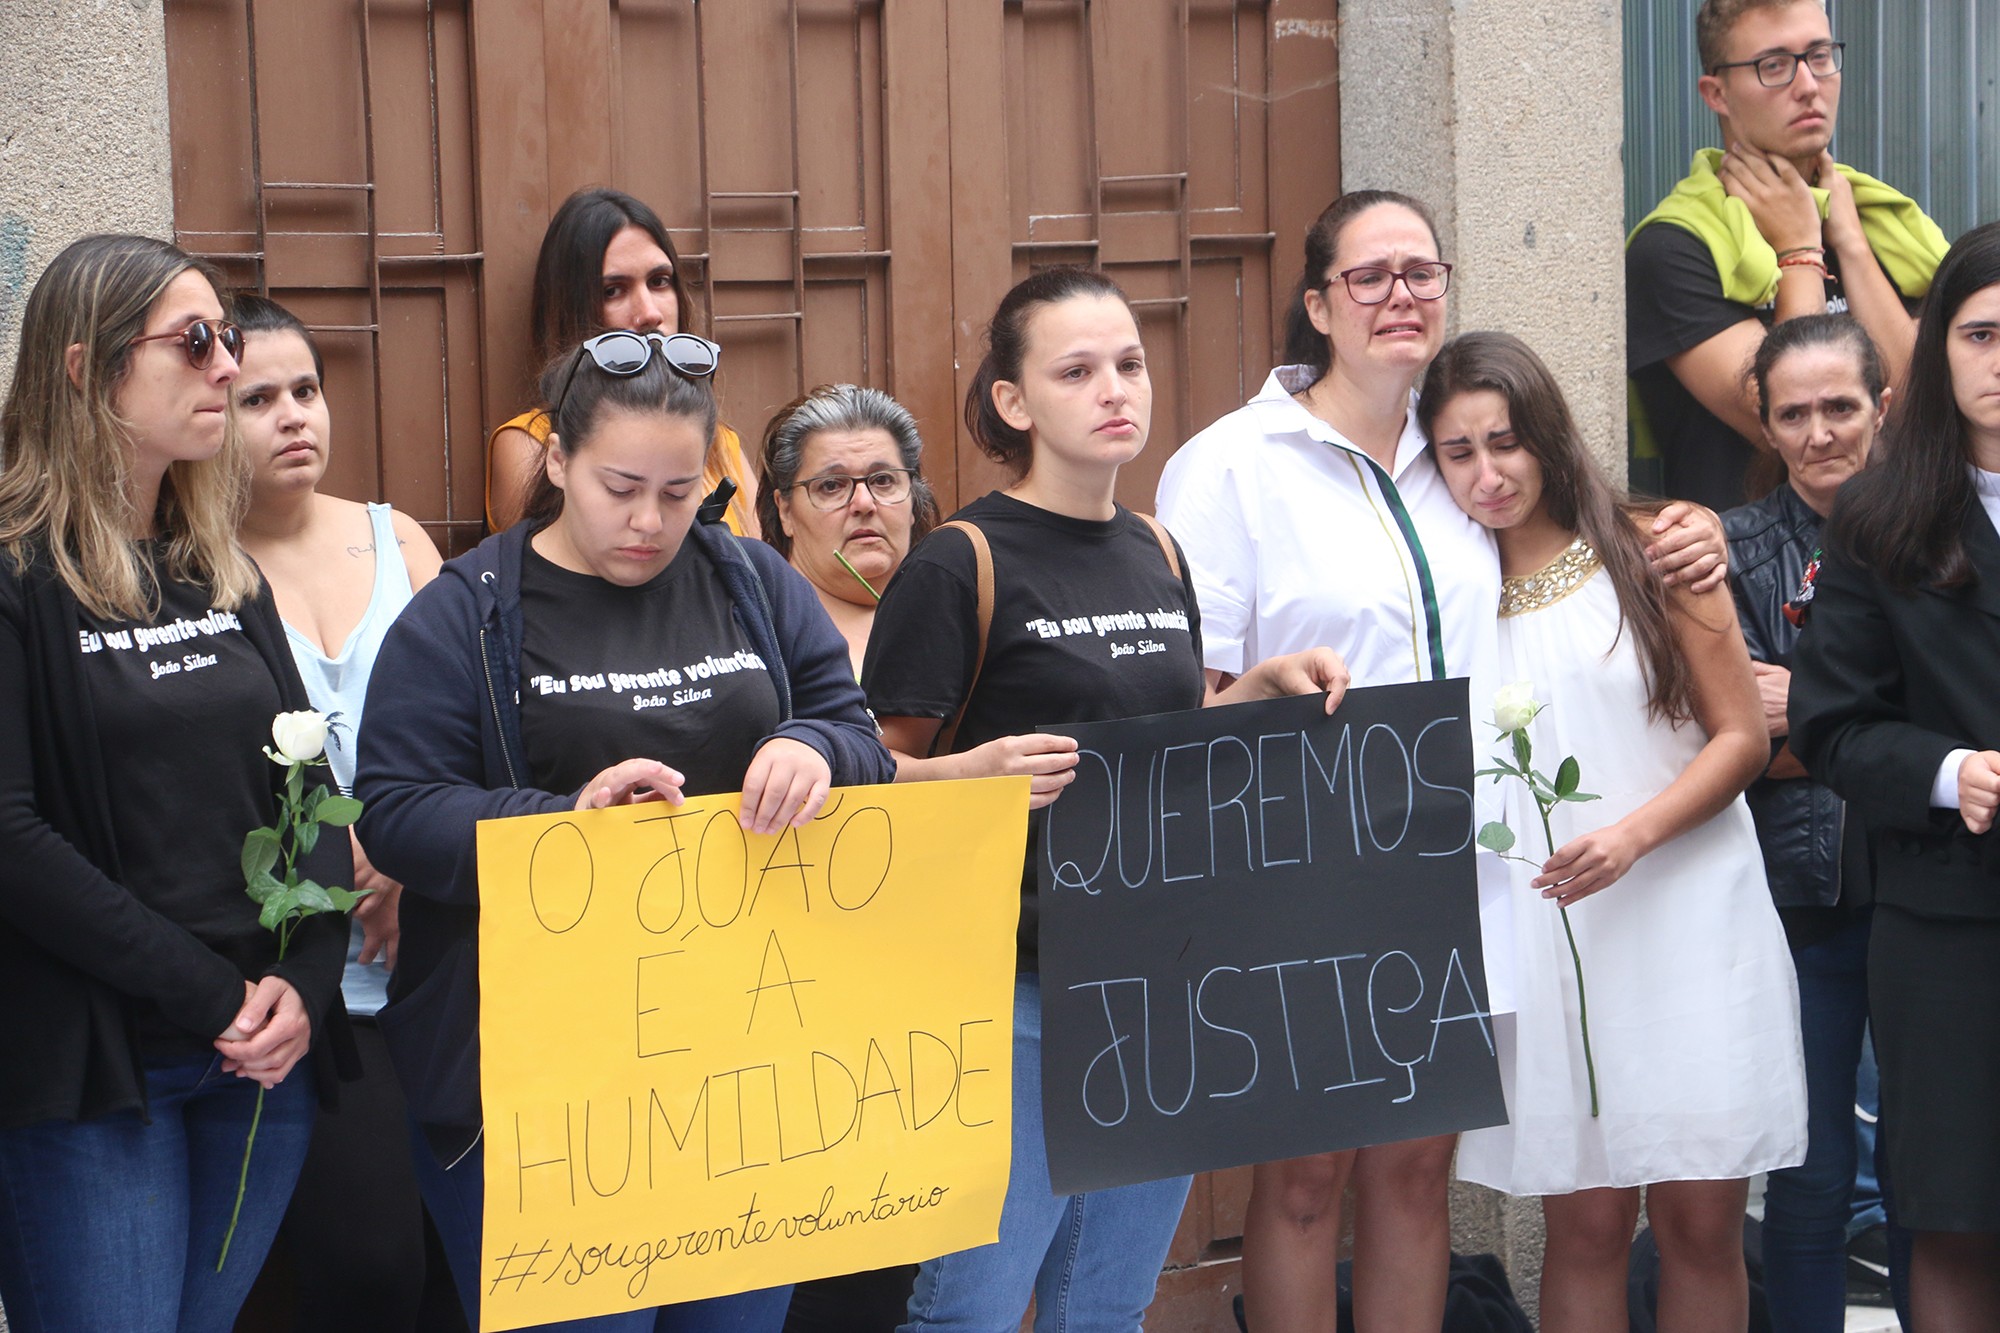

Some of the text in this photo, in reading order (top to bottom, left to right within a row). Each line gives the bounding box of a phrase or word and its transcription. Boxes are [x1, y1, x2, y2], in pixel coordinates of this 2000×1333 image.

[79, 630, 103, 653] Eu
[133, 617, 199, 652] gerente
[1062, 616, 1093, 636] sou
[1092, 610, 1147, 637] gerente
[1110, 640, 1167, 659] João Silva
[150, 653, 218, 680] João Silva
[569, 673, 607, 692] sou
[608, 668, 682, 693] gerente
[633, 687, 713, 711] João Silva
[1047, 717, 1475, 895] QUEREMOS
[529, 793, 893, 934] O JOÃO
[636, 924, 816, 1058] É A
[1068, 948, 1496, 1126] JUSTIÇA
[515, 1019, 994, 1214] HUMILDADE
[488, 1172, 950, 1300] #sougerentevoluntario
